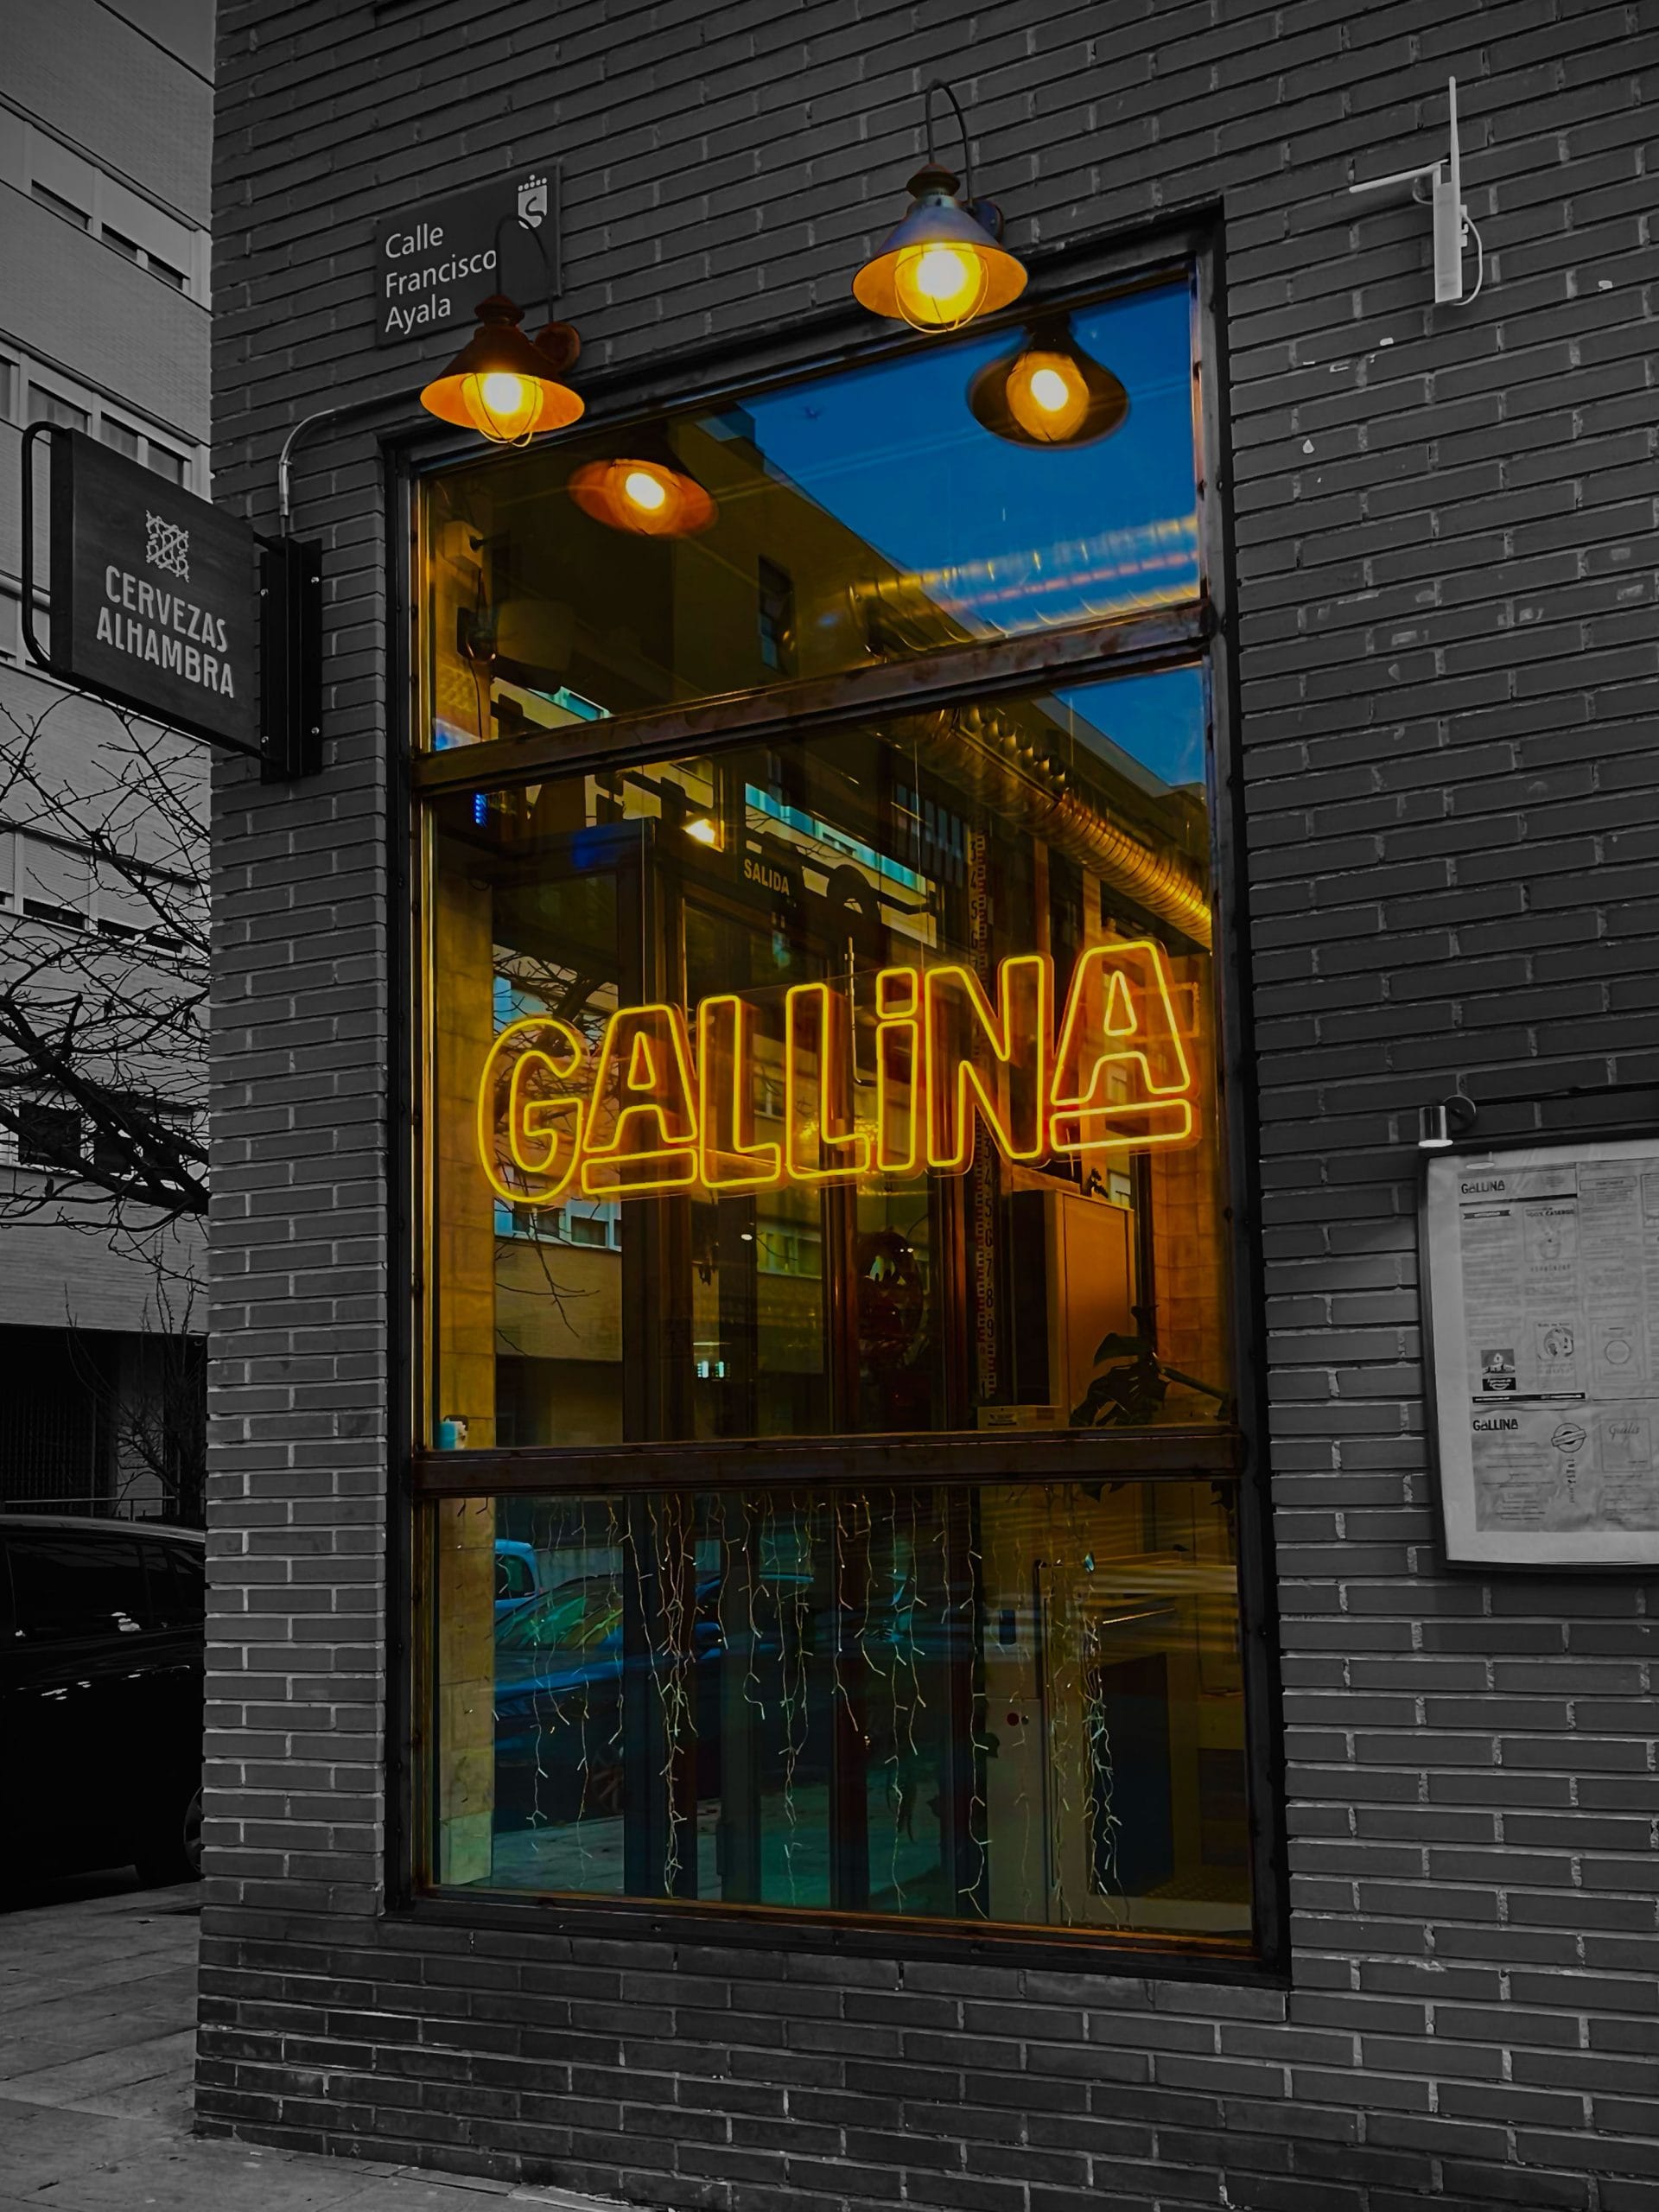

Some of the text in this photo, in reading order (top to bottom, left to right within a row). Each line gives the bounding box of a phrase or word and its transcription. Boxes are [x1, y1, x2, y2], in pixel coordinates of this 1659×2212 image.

[385, 223, 443, 258] Calle
[385, 250, 497, 298] Francisco
[385, 294, 451, 334] Ayala
[105, 565, 229, 652] CERVEZAS
[96, 607, 235, 698] ALHAMBRA
[744, 858, 790, 896] SALIDA
[1472, 1419, 1518, 1431] GALLINA
